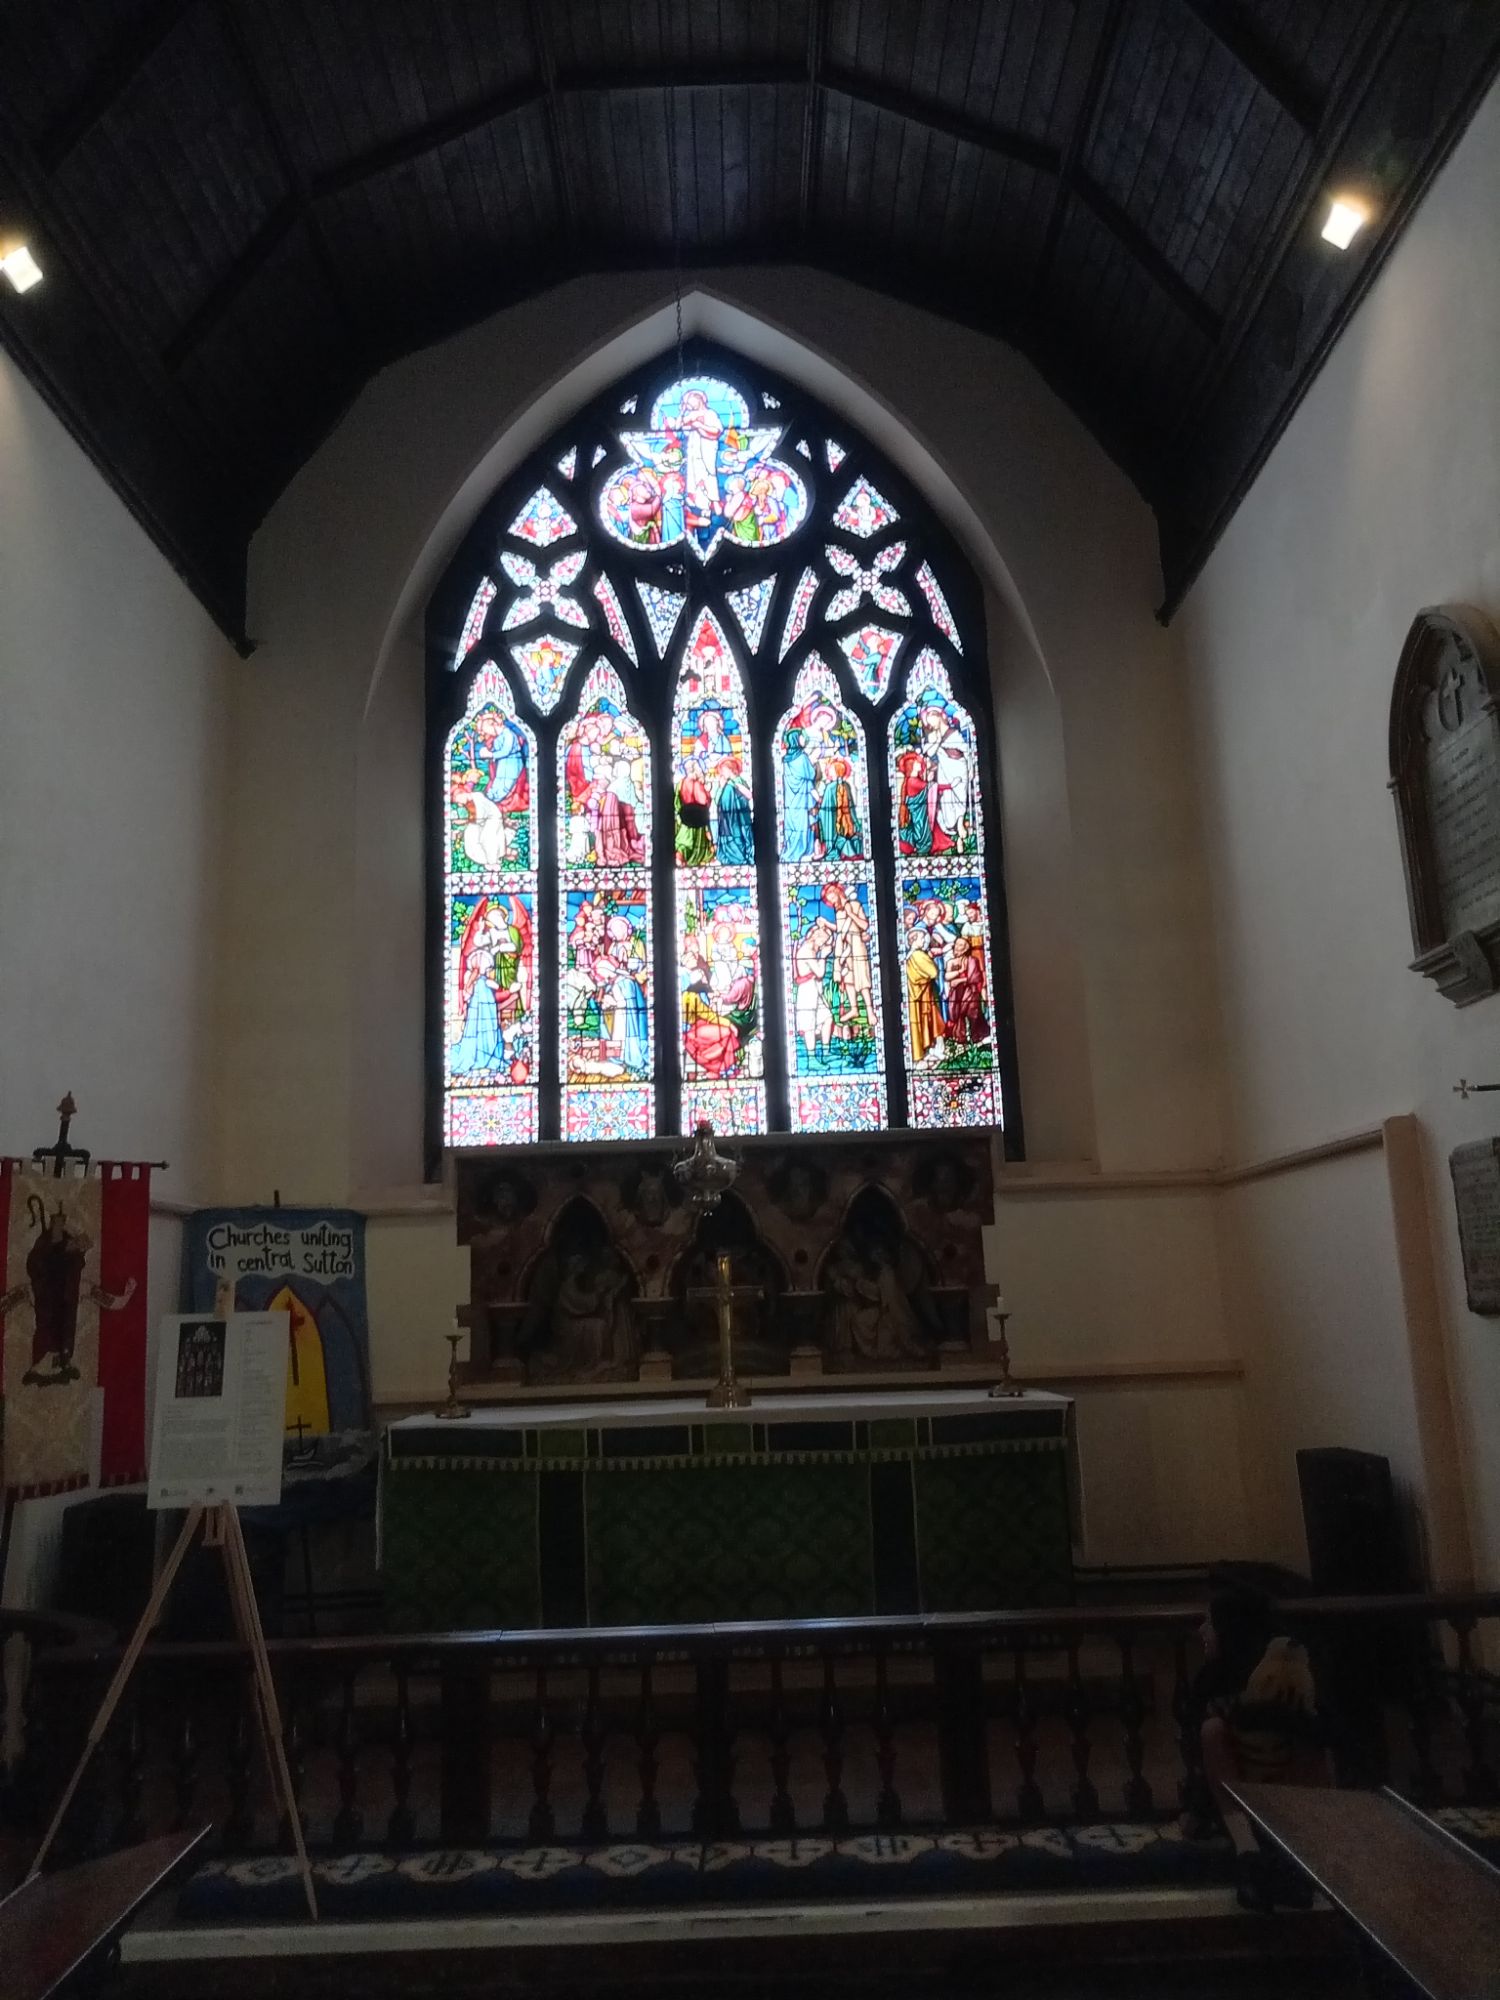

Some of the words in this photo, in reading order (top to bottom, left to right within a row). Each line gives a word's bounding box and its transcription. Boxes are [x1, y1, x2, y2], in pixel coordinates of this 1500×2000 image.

[209, 1225, 290, 1250] Churches
[302, 1224, 351, 1259] uniting
[210, 1250, 225, 1269] in
[238, 1247, 295, 1271] central
[303, 1249, 352, 1274] Sutton
